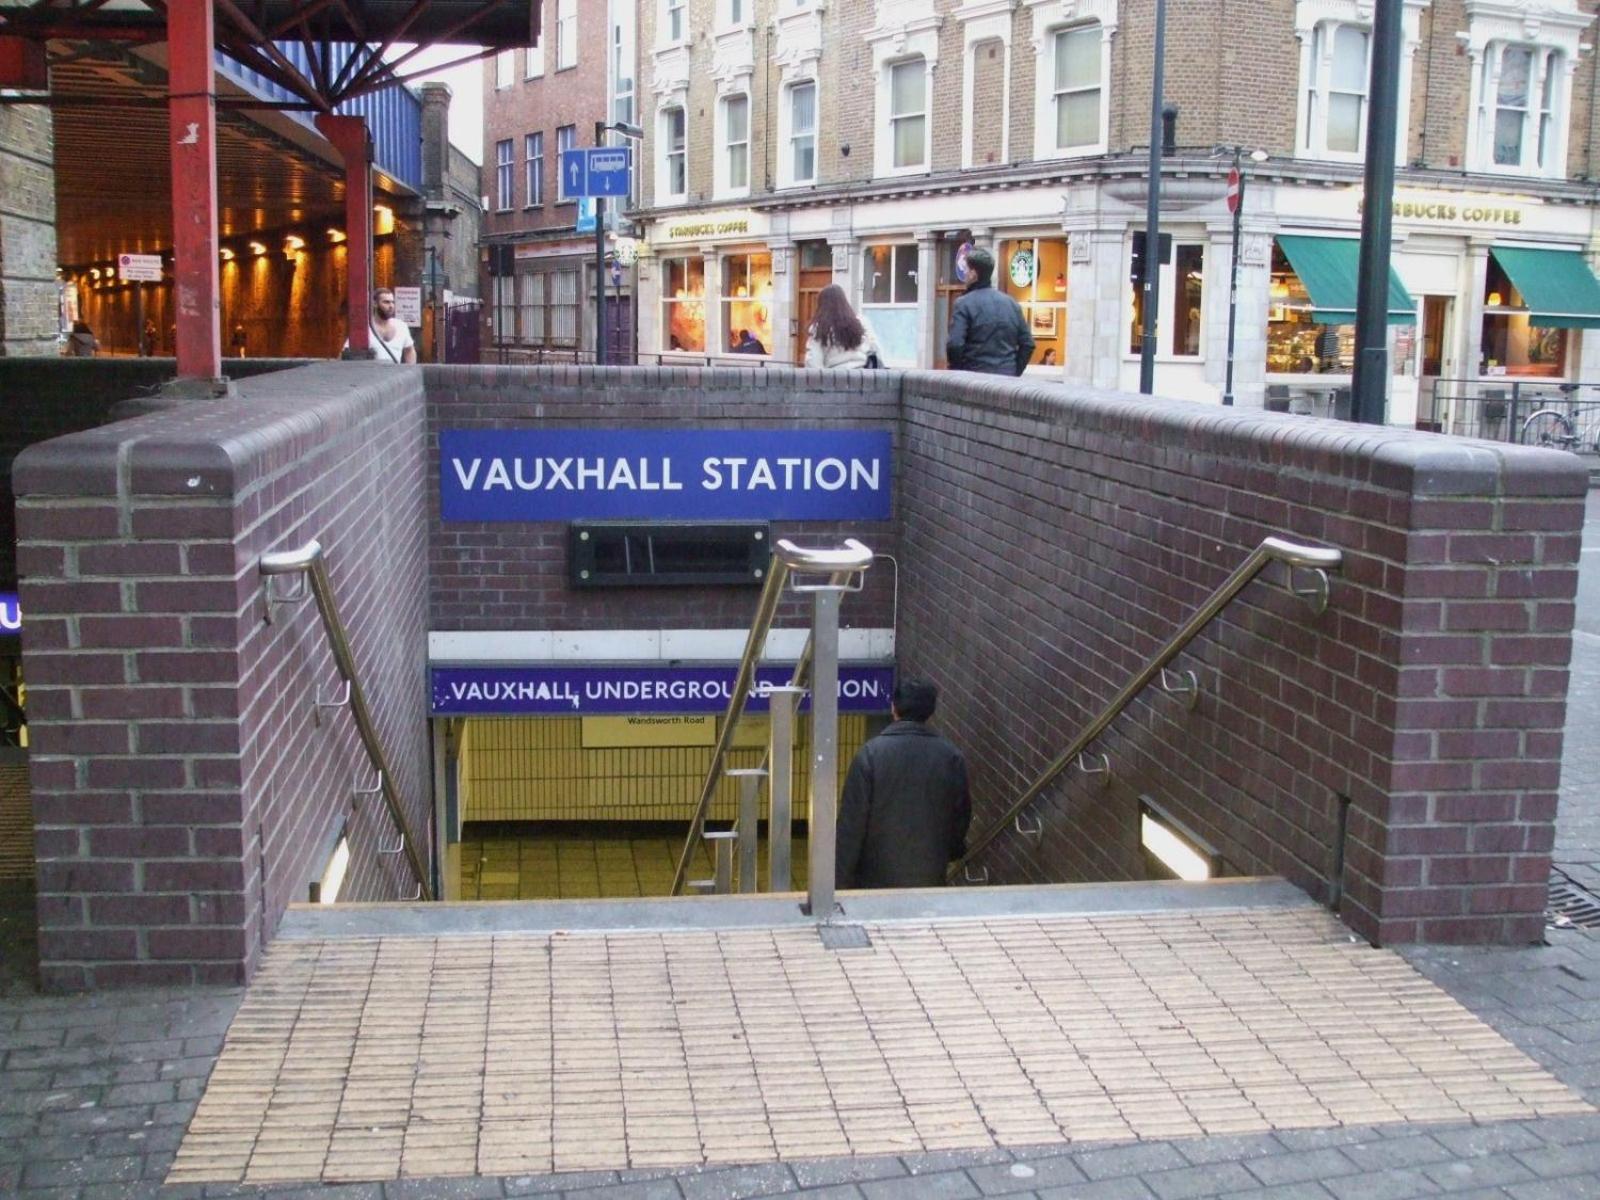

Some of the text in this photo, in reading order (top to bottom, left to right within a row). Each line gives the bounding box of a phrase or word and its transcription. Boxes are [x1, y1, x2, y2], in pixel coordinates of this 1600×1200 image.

[1462, 208, 1521, 225] COFFEE
[717, 220, 748, 234] COFFEE
[452, 456, 880, 491] VAUXHALL STATION
[450, 681, 577, 700] VAUXHALL
[627, 716, 705, 725] Wandsworth Road
